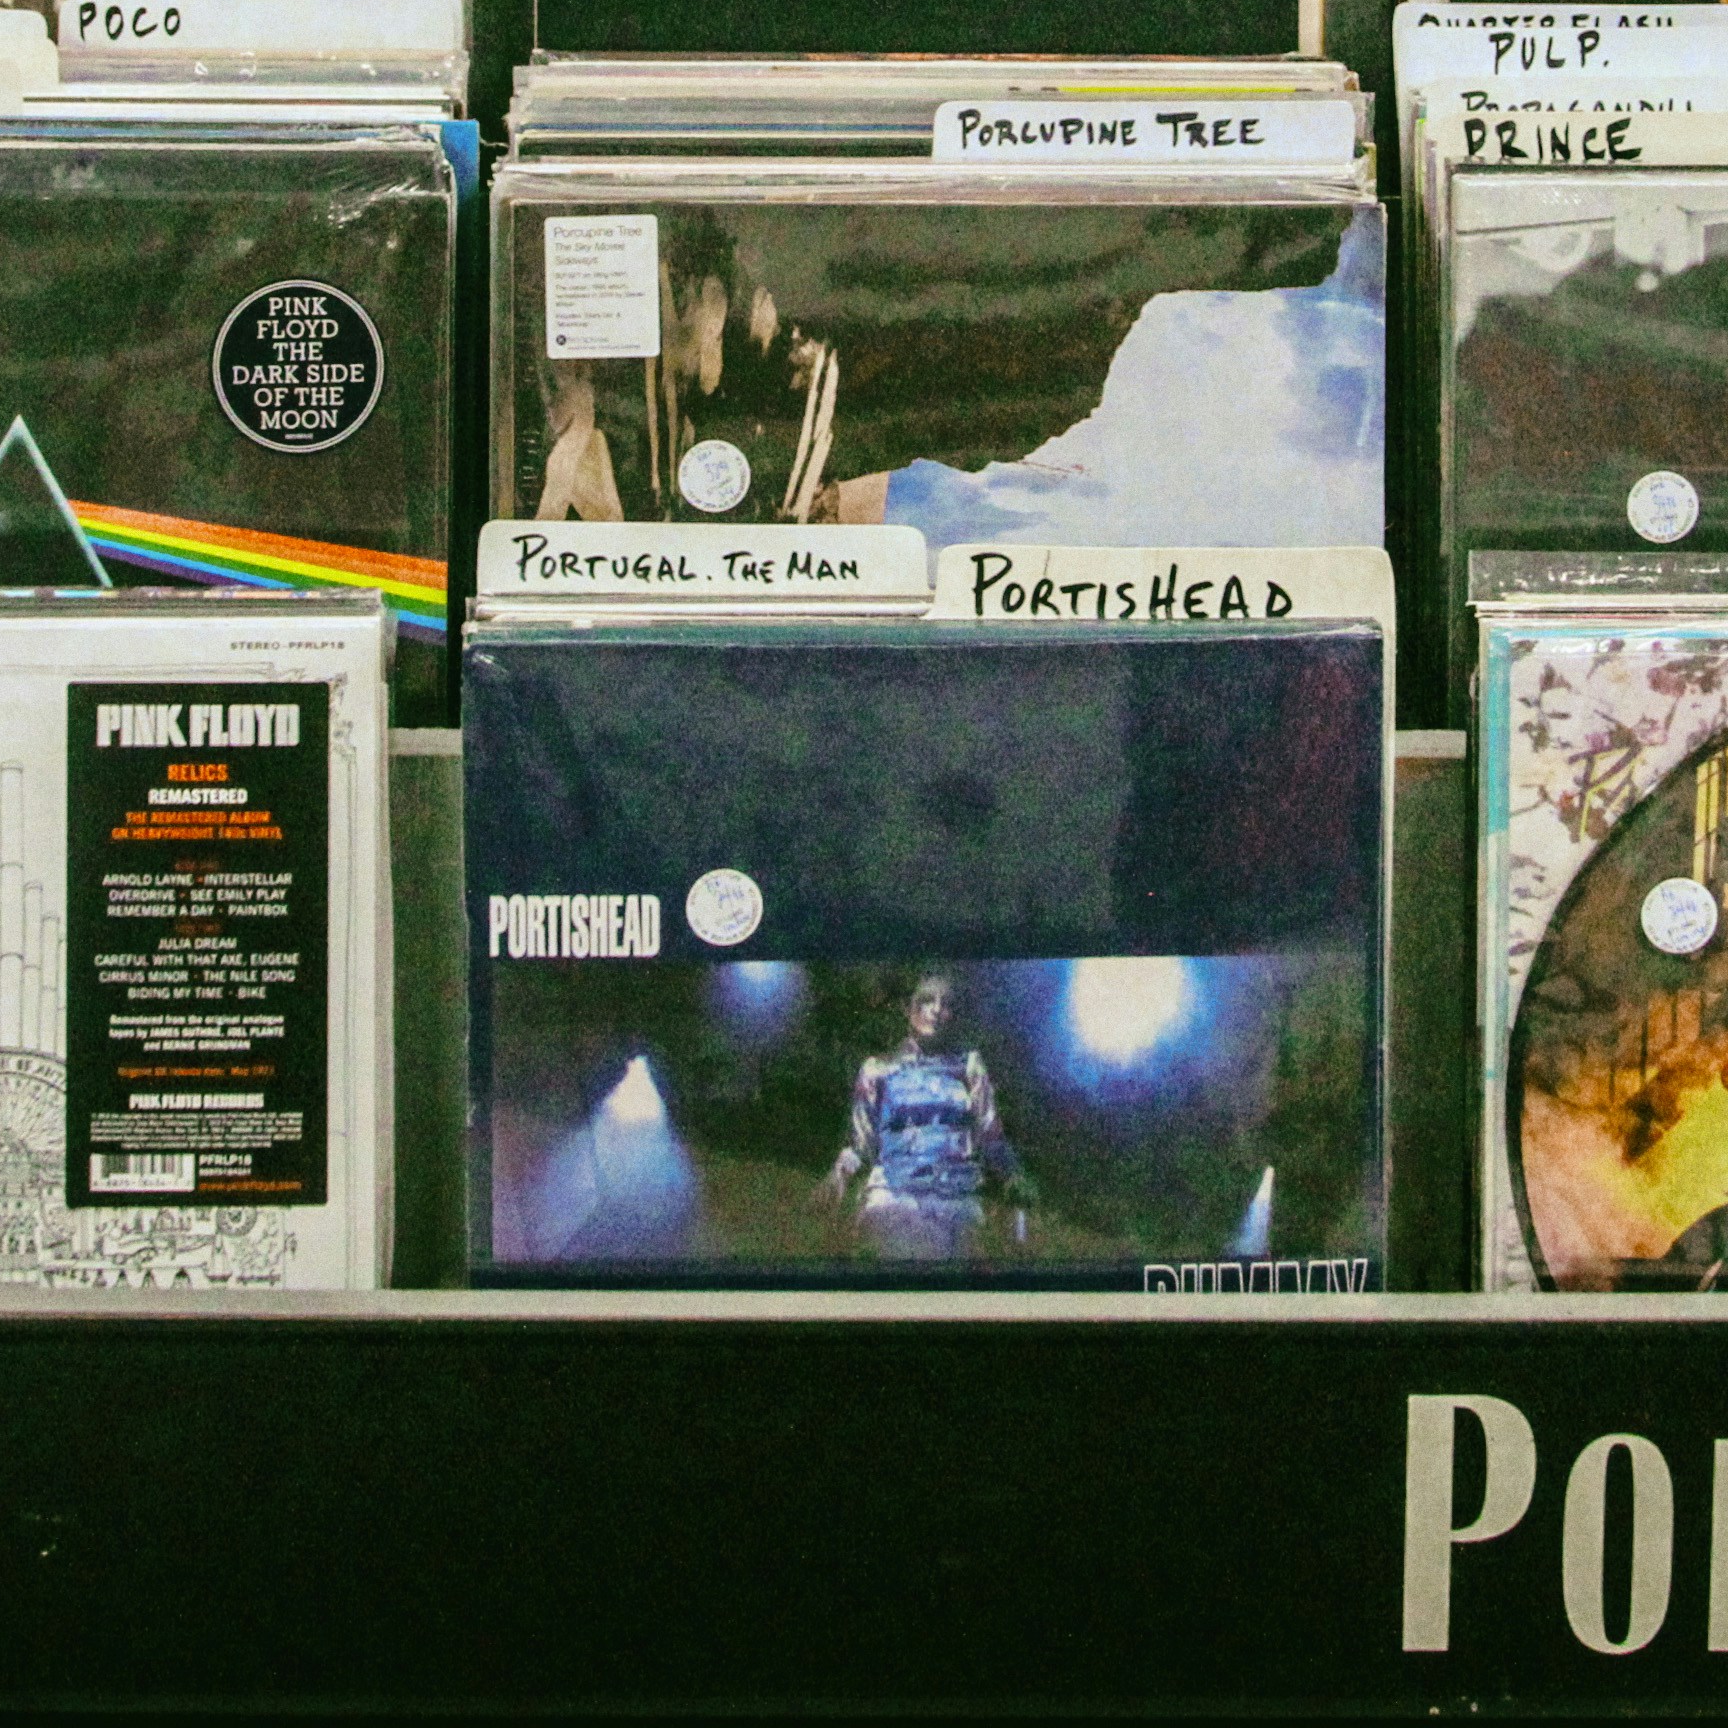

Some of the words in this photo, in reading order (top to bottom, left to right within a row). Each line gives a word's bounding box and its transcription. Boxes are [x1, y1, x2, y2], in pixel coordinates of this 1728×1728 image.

[77, 3, 183, 43] POCO
[957, 108, 1137, 149] PORCUPINE
[1156, 111, 1266, 149] TREE
[1463, 118, 1643, 161] PRINCE
[617, 225, 642, 236] Tree
[269, 297, 328, 316] PINK
[257, 319, 338, 339] FLOYD
[272, 341, 324, 361] THE
[232, 365, 300, 385] DARK
[306, 364, 365, 383] SIDE
[254, 388, 289, 407] OF
[294, 386, 344, 406] THE
[260, 409, 338, 430] MOON
[723, 555, 777, 585] THE
[787, 554, 861, 583] MAN
[970, 552, 1294, 620] PORTISHEAD
[96, 704, 187, 747] PINK
[189, 704, 300, 747] FLOYD
[168, 764, 228, 782] RELICS
[148, 788, 248, 805] REMASTERED
[102, 874, 152, 886] ARNOLD
[155, 874, 194, 886] LAYNE
[488, 893, 662, 960] PORTISHEAD
